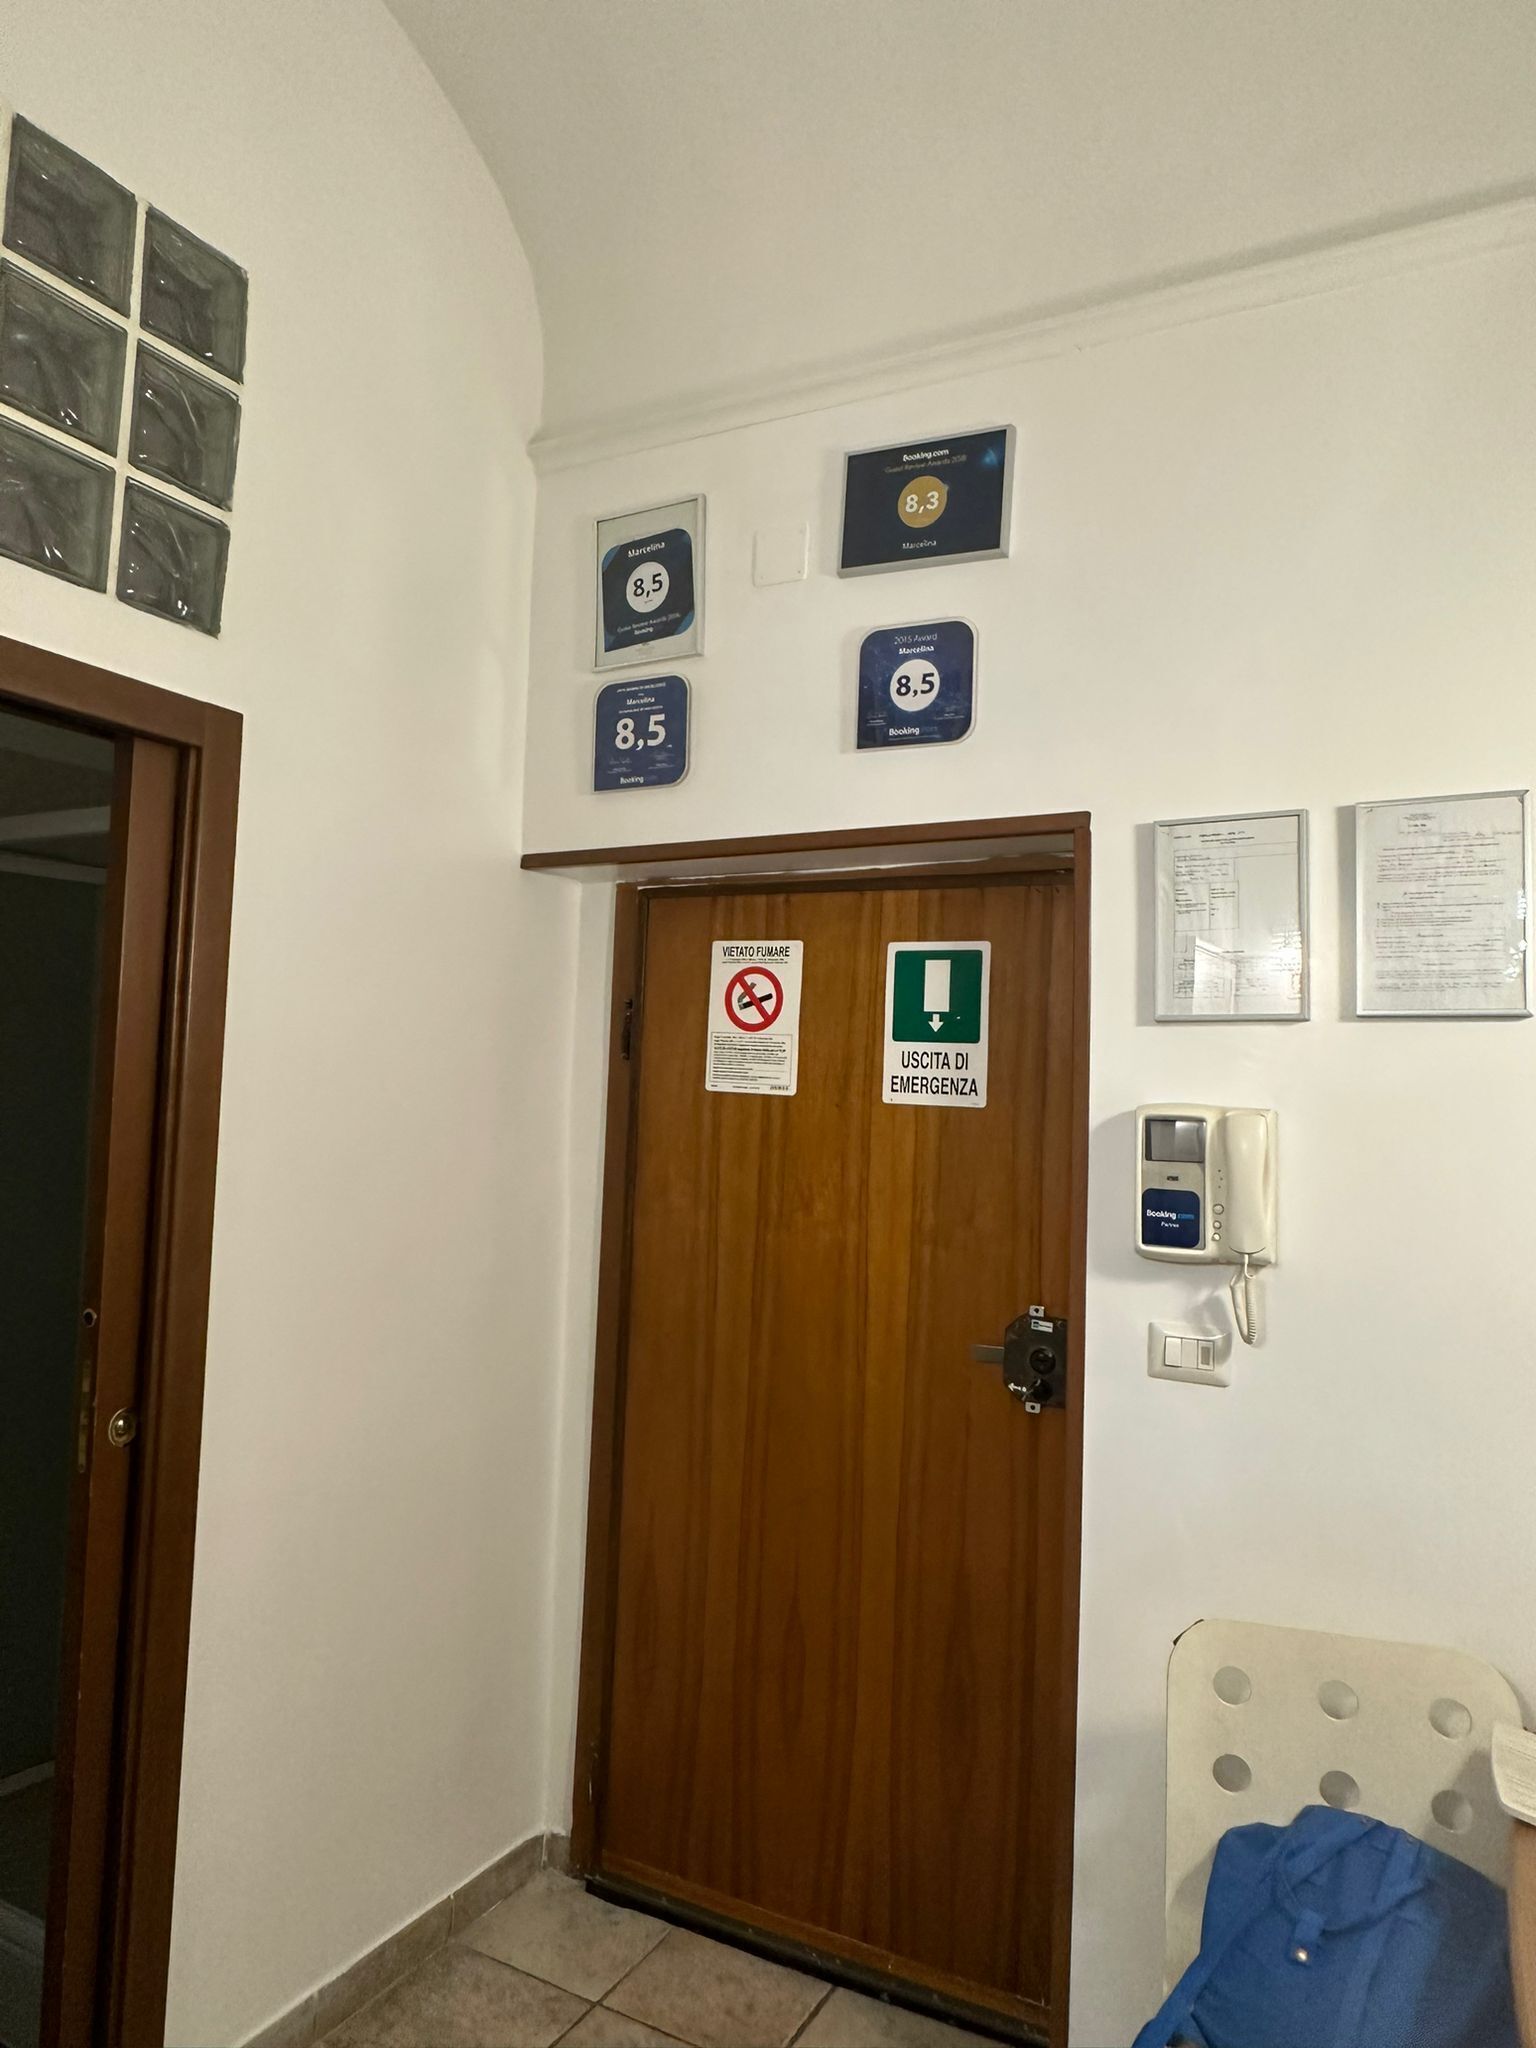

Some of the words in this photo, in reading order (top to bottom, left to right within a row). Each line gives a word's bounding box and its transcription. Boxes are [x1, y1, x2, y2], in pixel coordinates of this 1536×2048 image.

[903, 449, 949, 462] Booking.com
[905, 490, 939, 514] 8,3
[627, 542, 666, 558] Marcelina
[902, 540, 937, 549] Marcelina
[633, 572, 663, 598] 8,5
[894, 634, 912, 645] 2015
[913, 633, 938, 643] Award
[899, 645, 935, 654] Marcelina
[896, 672, 935, 697] 8,5
[626, 696, 655, 705] Marcelina
[615, 713, 666, 751] 8,5
[889, 726, 920, 736] Booking
[722, 946, 755, 957] VIETATO
[756, 946, 790, 957] FUMARE
[901, 1050, 951, 1070] USCITA
[955, 1052, 969, 1070] DI
[890, 1075, 978, 1096] EMERGENZA
[1146, 1209, 1194, 1220] Booking
